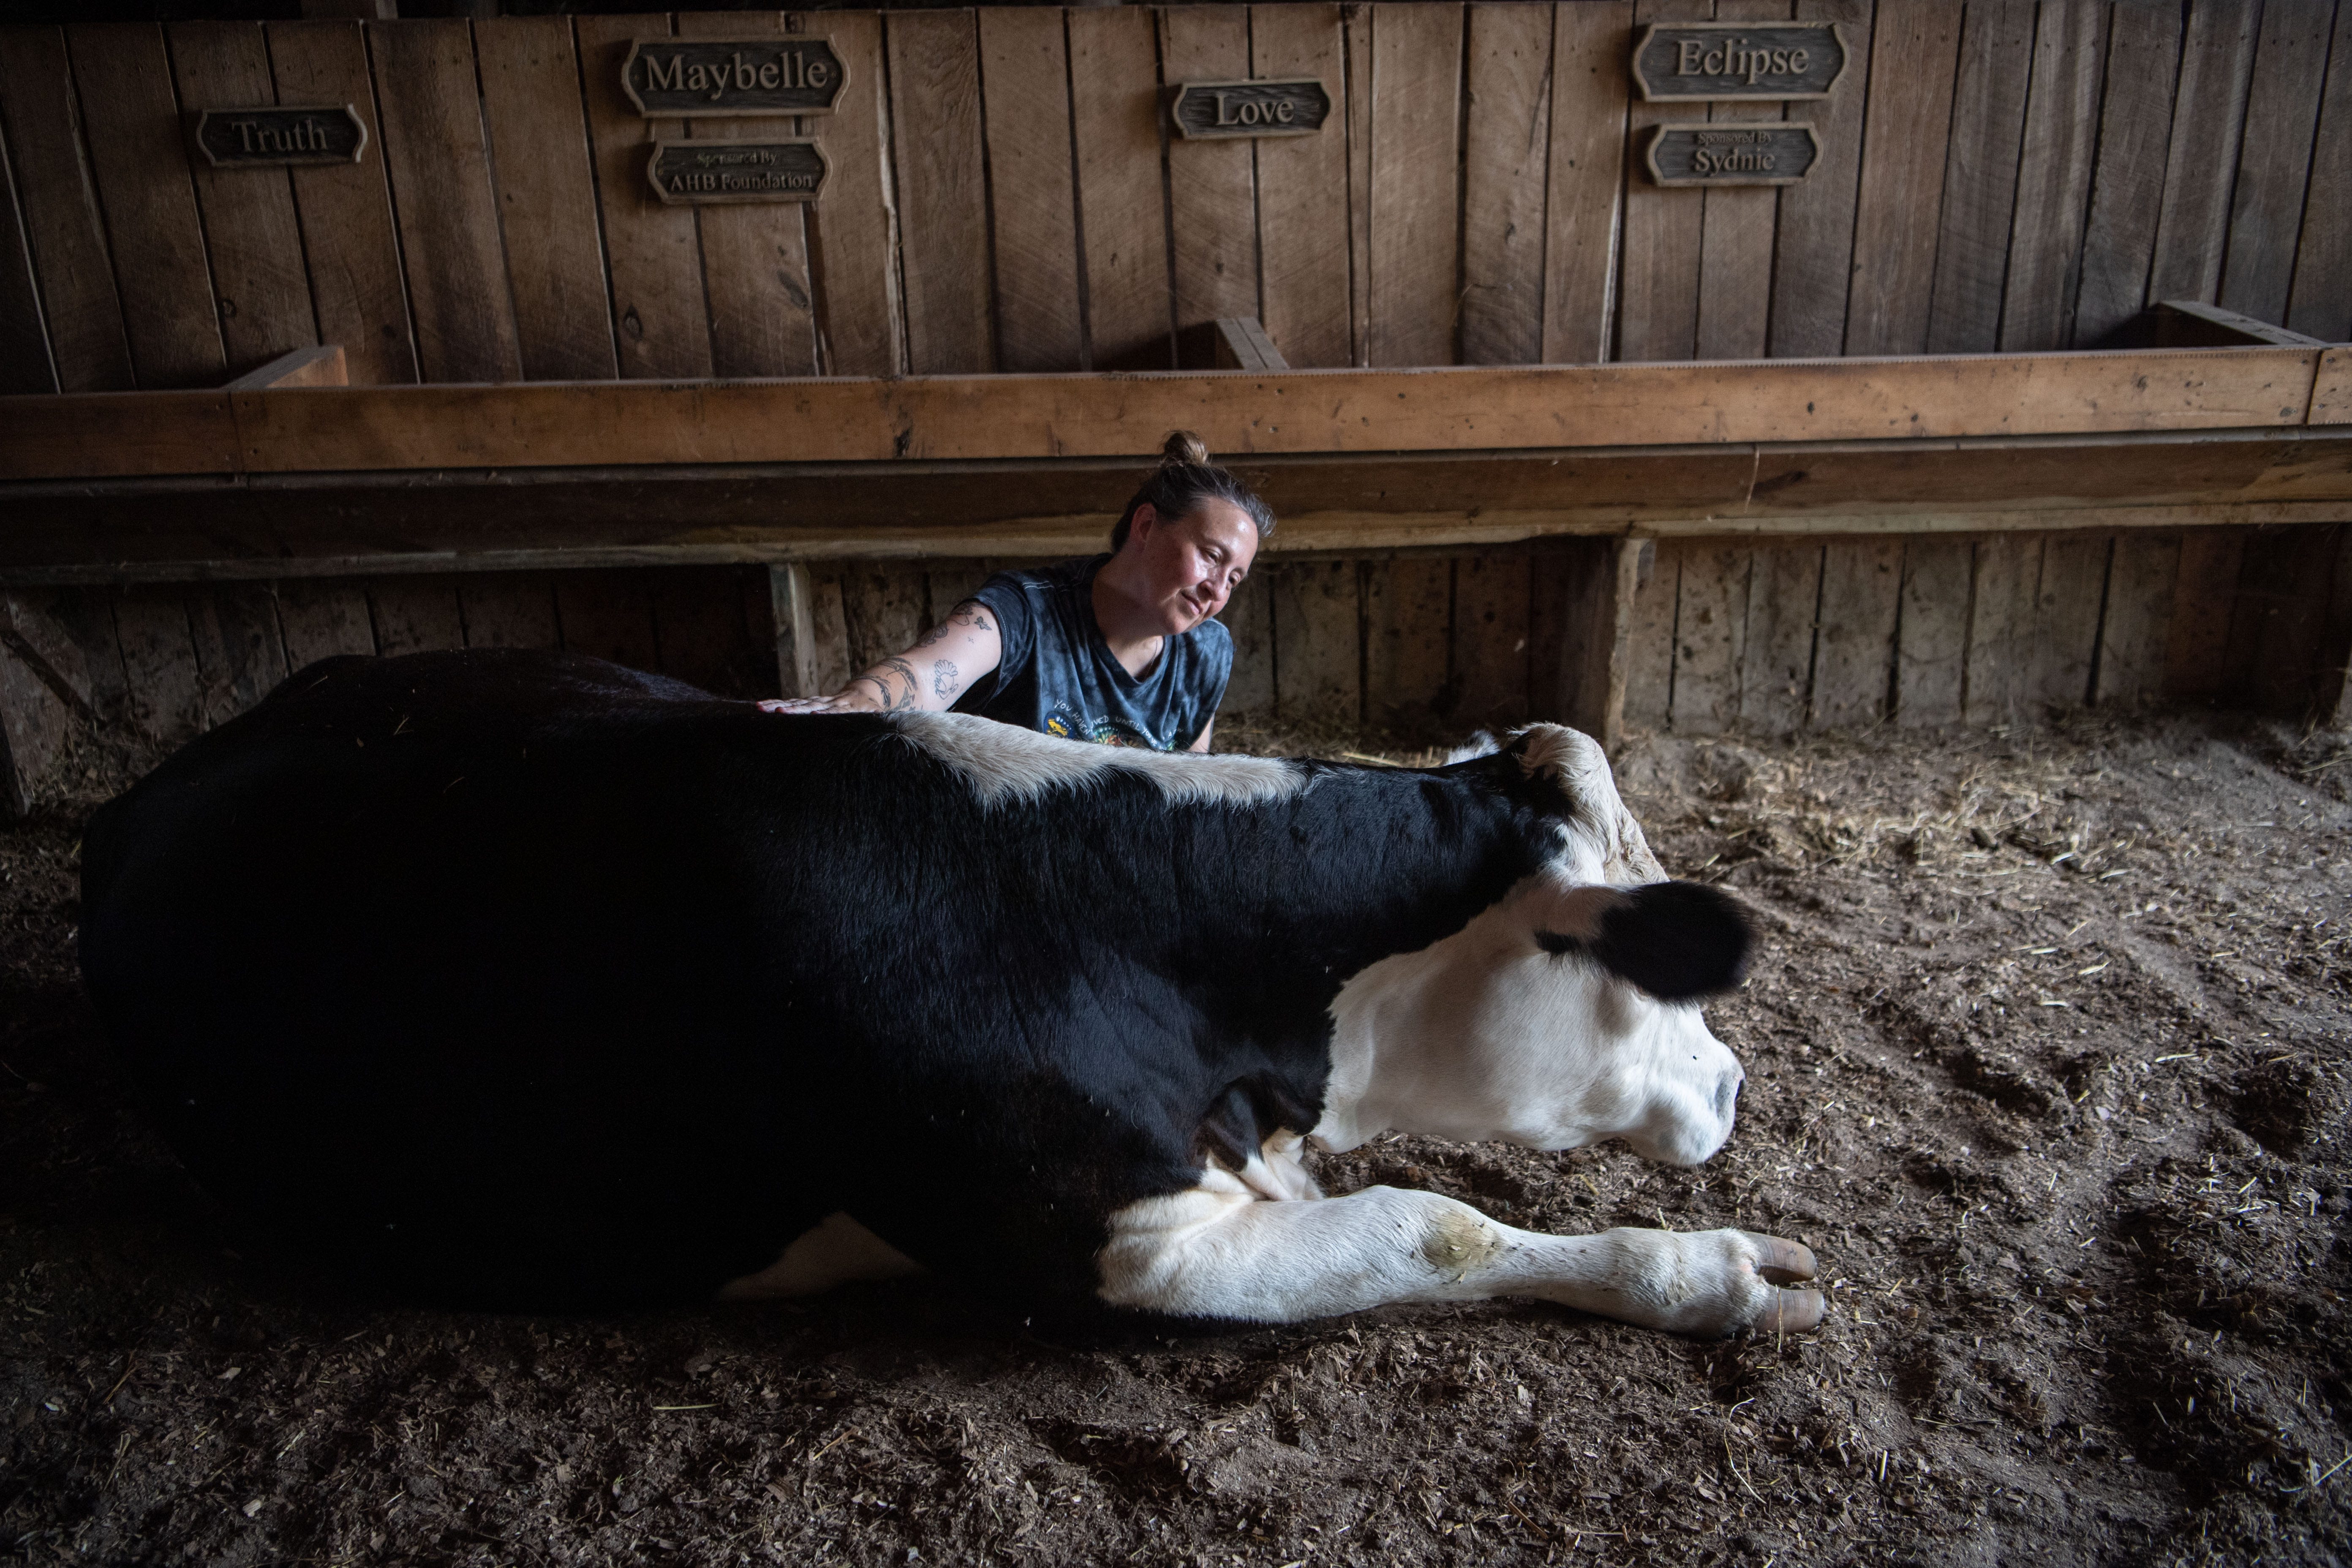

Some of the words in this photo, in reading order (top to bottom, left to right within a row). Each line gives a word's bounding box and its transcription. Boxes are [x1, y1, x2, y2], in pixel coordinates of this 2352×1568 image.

[645, 50, 828, 101] Maybelle
[1677, 38, 1810, 85] Eclipse
[1215, 90, 1295, 125] Love
[231, 117, 329, 154] Truth
[1697, 132, 1755, 146] Sponsored
[1757, 131, 1772, 145] By
[760, 150, 777, 166] By
[1694, 148, 1776, 177] Sydnie
[670, 174, 716, 191] AHB
[721, 172, 813, 191] Foundation
[1054, 699, 1073, 711] YOU
[1115, 716, 1140, 731] UNTIL
